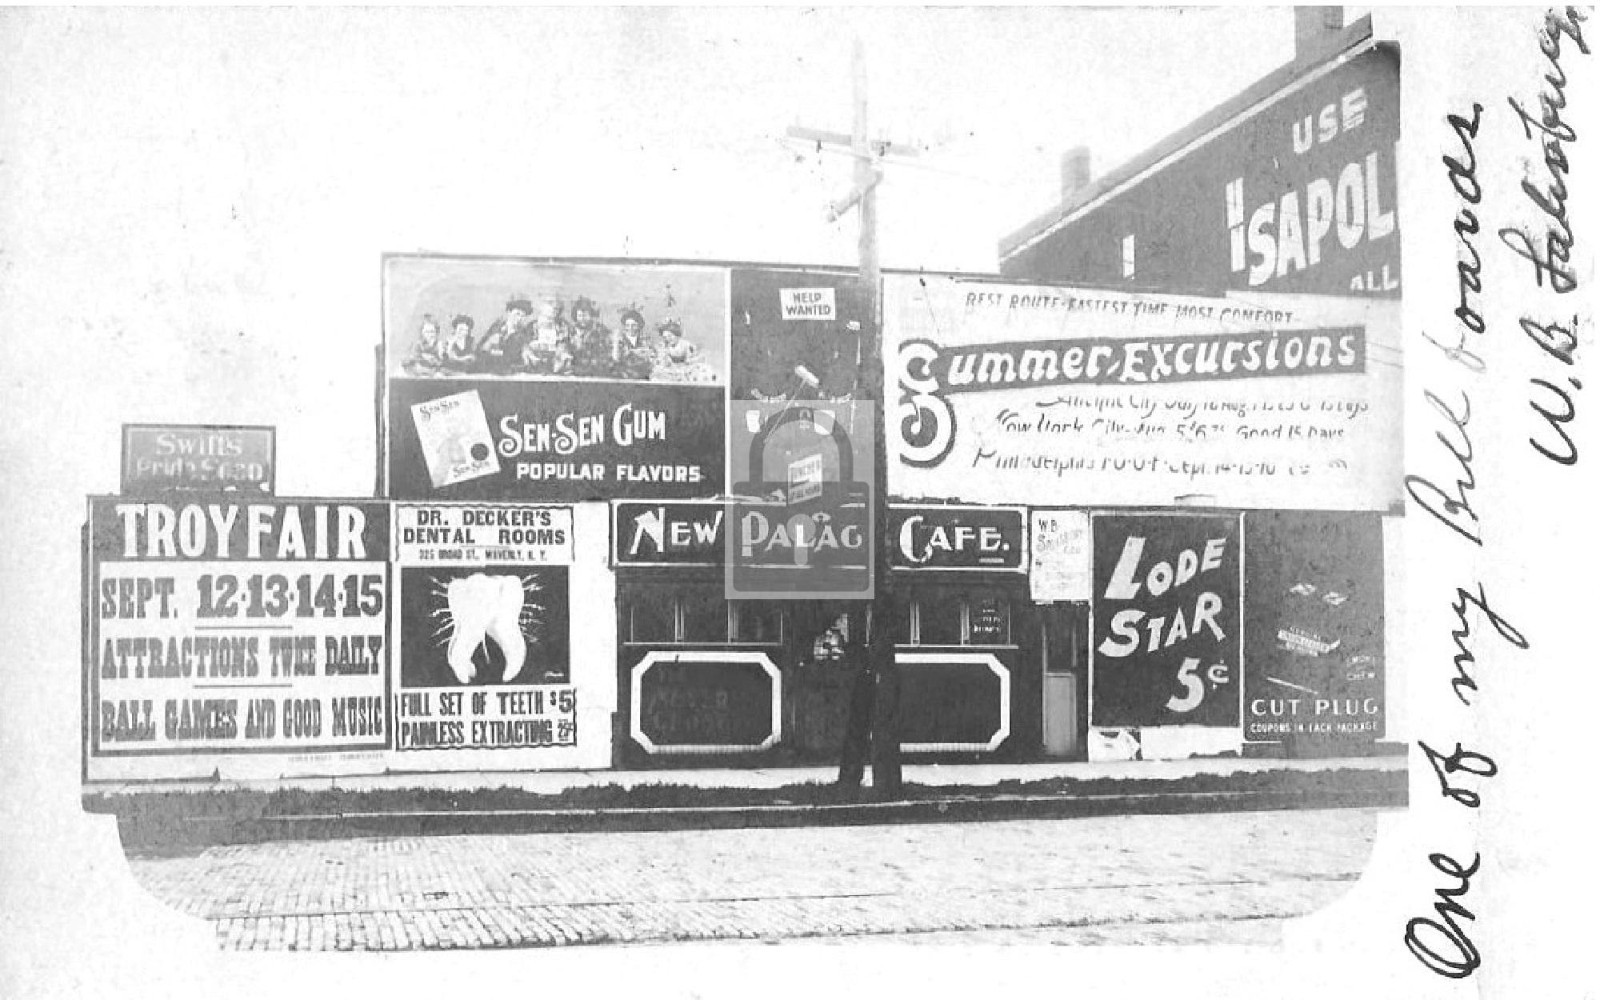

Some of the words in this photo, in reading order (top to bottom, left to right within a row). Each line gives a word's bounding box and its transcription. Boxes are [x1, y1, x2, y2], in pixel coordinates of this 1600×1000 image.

[1293, 87, 1368, 154] USE
[793, 292, 822, 303] HELP
[1350, 265, 1399, 291] ALL
[786, 304, 831, 316] WANTED
[612, 402, 666, 447] GUM
[516, 461, 605, 481] POPULAR
[616, 464, 701, 482] FLAVORS
[115, 503, 239, 558] TROY
[247, 504, 367, 559] FAIR
[403, 528, 476, 545] DENTAL
[498, 529, 566, 545] ROOMS
[417, 509, 449, 526] DR.
[462, 509, 551, 527] DECKER'S
[629, 507, 724, 555] NEW
[741, 509, 863, 557] PALAC
[1103, 535, 1227, 600] LODE
[101, 577, 178, 620] SEPT.
[1098, 591, 1227, 658] STAR
[1450, 582, 1529, 706] my
[101, 636, 259, 680] ATTRACTIONS
[268, 635, 317, 678] TWICE
[324, 634, 383, 677] DAILY
[101, 698, 156, 742] BALL
[164, 698, 238, 741] GAMES
[245, 698, 276, 740] AND
[282, 698, 322, 740] GOOD
[331, 695, 383, 738] MUSIC
[401, 692, 432, 717] FULL
[439, 692, 464, 716] SET
[471, 691, 488, 716] OF
[496, 690, 544, 715] TEETH
[1251, 698, 1302, 717] CUT
[1314, 697, 1379, 716] PLUG
[401, 720, 464, 746] PAINLESS
[472, 718, 553, 745] EXTRACTING
[1417, 740, 1497, 808] of
[1404, 852, 1482, 979] One
